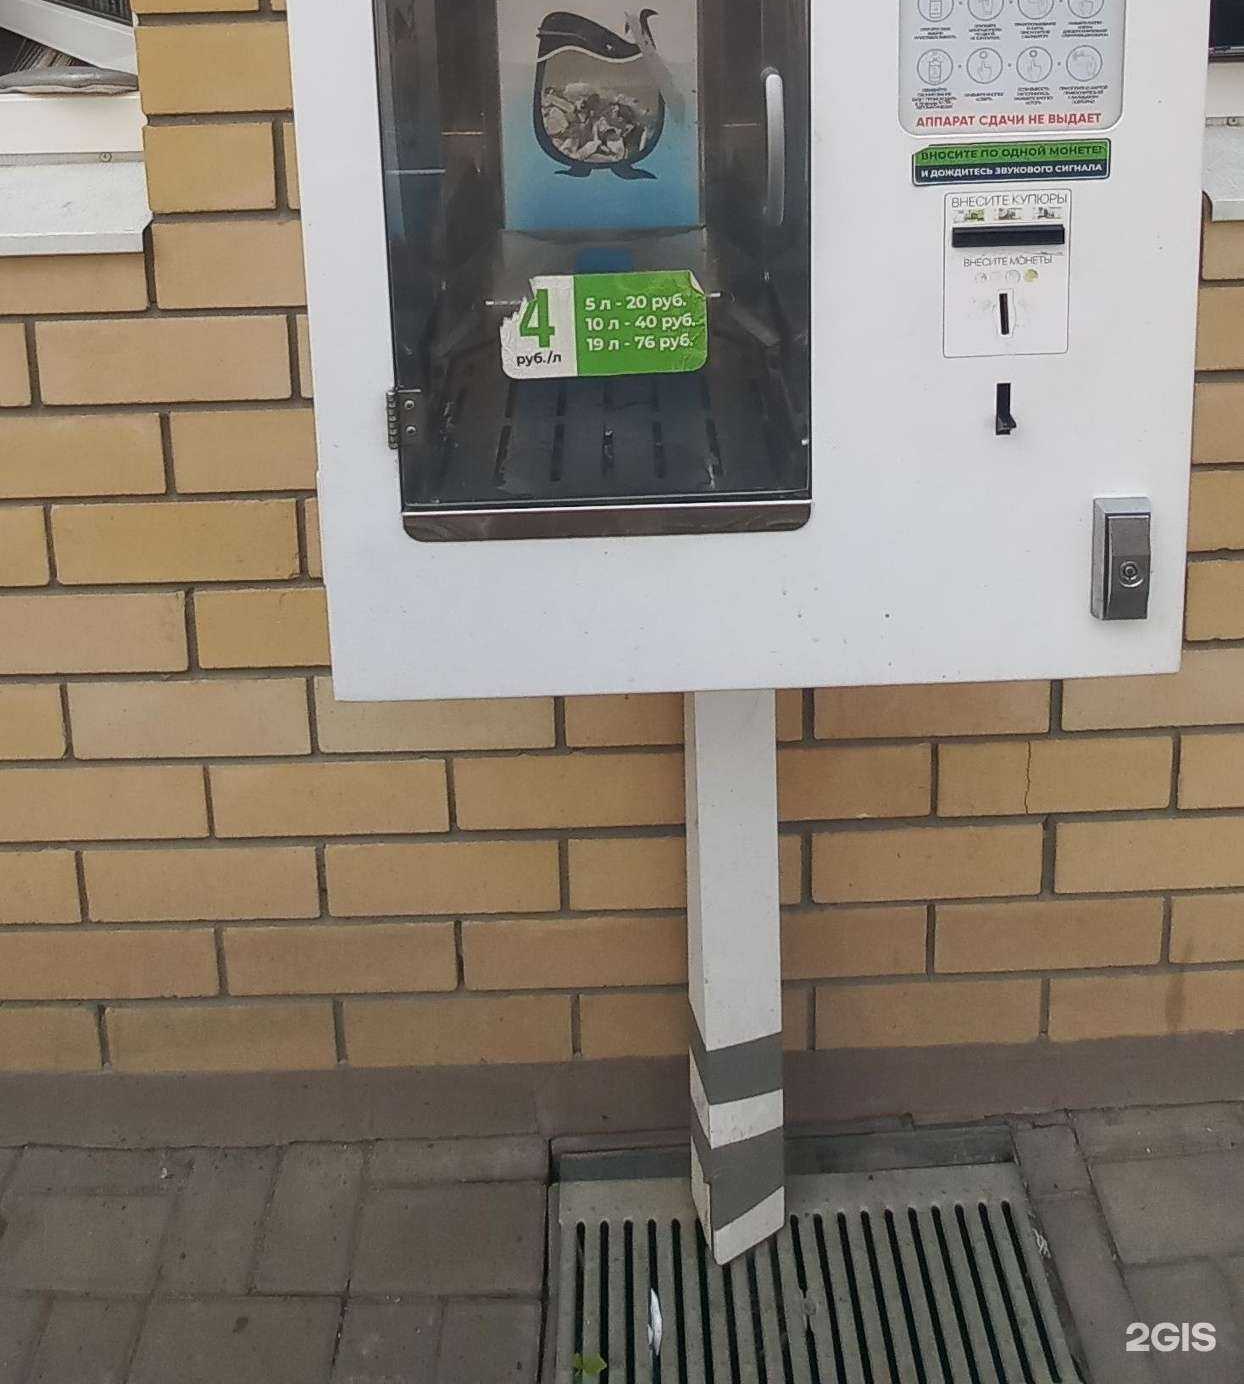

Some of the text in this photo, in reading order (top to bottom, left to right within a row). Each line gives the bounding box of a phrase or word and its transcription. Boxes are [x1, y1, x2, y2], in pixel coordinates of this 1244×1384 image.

[916, 112, 1102, 128] АППАРАТ СДАЧИ НЕ ВЫДАЕТ
[921, 149, 977, 160] ВНОСИТЕ
[980, 148, 999, 158] ПО
[1001, 146, 1047, 159] ОДНОЙ
[930, 167, 993, 179] ДОЖДИТЕСЬ
[994, 166, 1053, 176] ЗВУКОВОГО
[1055, 163, 1103, 174] СИГНАЛА
[951, 192, 1068, 208] ВНЕСИТЕ КУПЮРЫ
[1009, 255, 1053, 266] МОНЕТЫ
[585, 298, 596, 311] 5
[599, 299, 611, 309] л
[626, 296, 647, 309] 20
[652, 293, 687, 311] руб.
[519, 288, 555, 348] 4
[586, 317, 604, 331] 10
[607, 319, 619, 330] л
[634, 315, 657, 329] 40
[662, 313, 696, 331] руб.
[586, 337, 604, 351] 19
[607, 339, 620, 350] л
[634, 335, 655, 348] 76
[659, 333, 695, 351] руб.
[517, 351, 562, 366] руб./л
